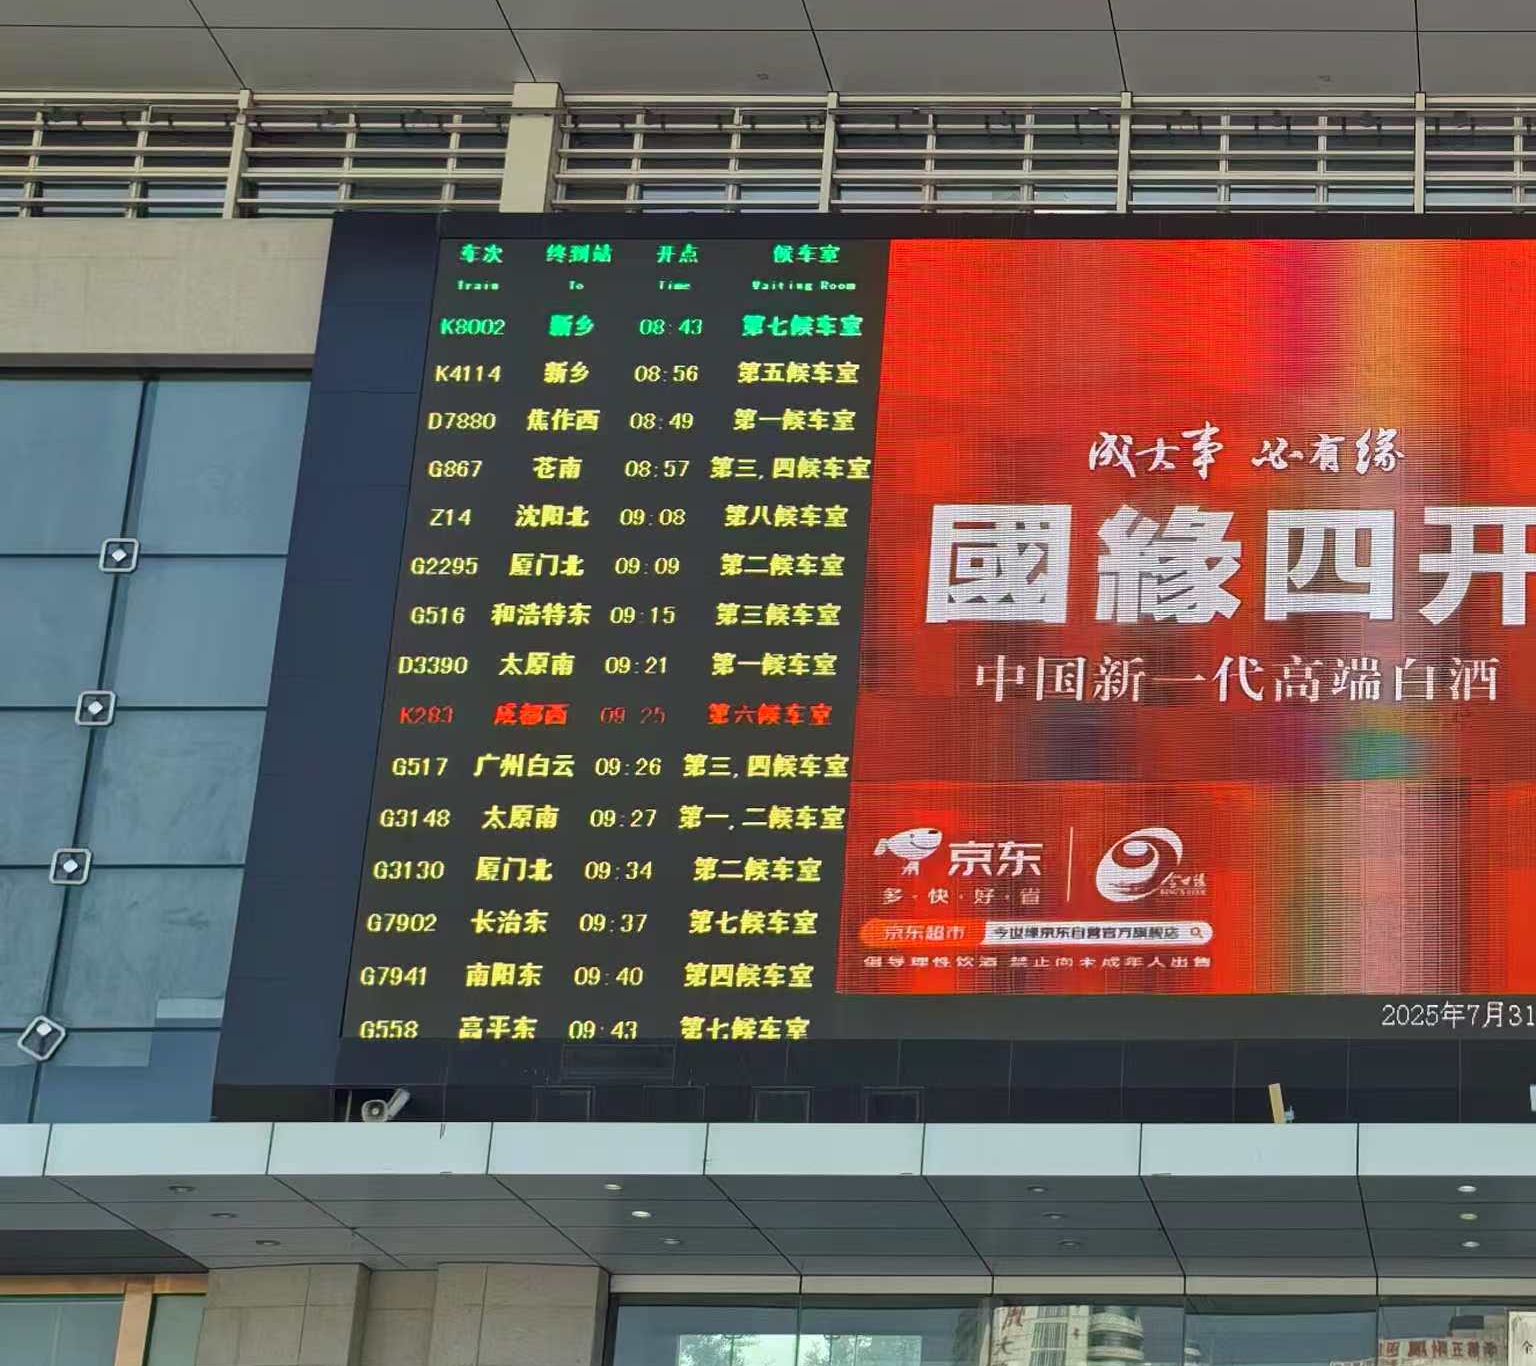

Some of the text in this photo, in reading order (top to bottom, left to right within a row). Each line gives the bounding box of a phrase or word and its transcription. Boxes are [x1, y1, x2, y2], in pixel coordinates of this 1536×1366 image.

[460, 243, 840, 264] 车次 终到站 开点 候车室
[439, 314, 863, 338] K8002 08:43 第七候车室
[434, 362, 859, 385] K4114 新乡 08:56 第五候车室
[427, 408, 855, 432] D7880 焦作西 08:49 第一候车室
[427, 460, 480, 478] G867
[624, 460, 688, 477] 08:57
[429, 504, 847, 529] Z14 沈阳北 09:08 第八候车室
[410, 554, 844, 576] G2295 09:09 第二候车室
[409, 606, 464, 625] G516
[609, 607, 675, 625] 09:15
[716, 603, 840, 627] 第三候车室
[397, 651, 837, 676] D3390 太原南 09:21 第一候车室
[976, 654, 1499, 702] 中国新一代高端白酒
[392, 757, 448, 776] G517
[473, 753, 575, 779] 广州白云
[594, 757, 662, 776] 09:26
[379, 810, 449, 827] G3148
[481, 804, 558, 830] 太原南
[589, 810, 655, 827] 09:27
[372, 858, 822, 883] G3130 09:34 第二候车室
[948, 840, 1042, 876] 京东
[366, 909, 816, 935] G7902 长治东 09:37 第七候车室
[884, 926, 965, 941] 京东超市
[360, 962, 814, 988] G7941 南阳东 09:40 第四候车室
